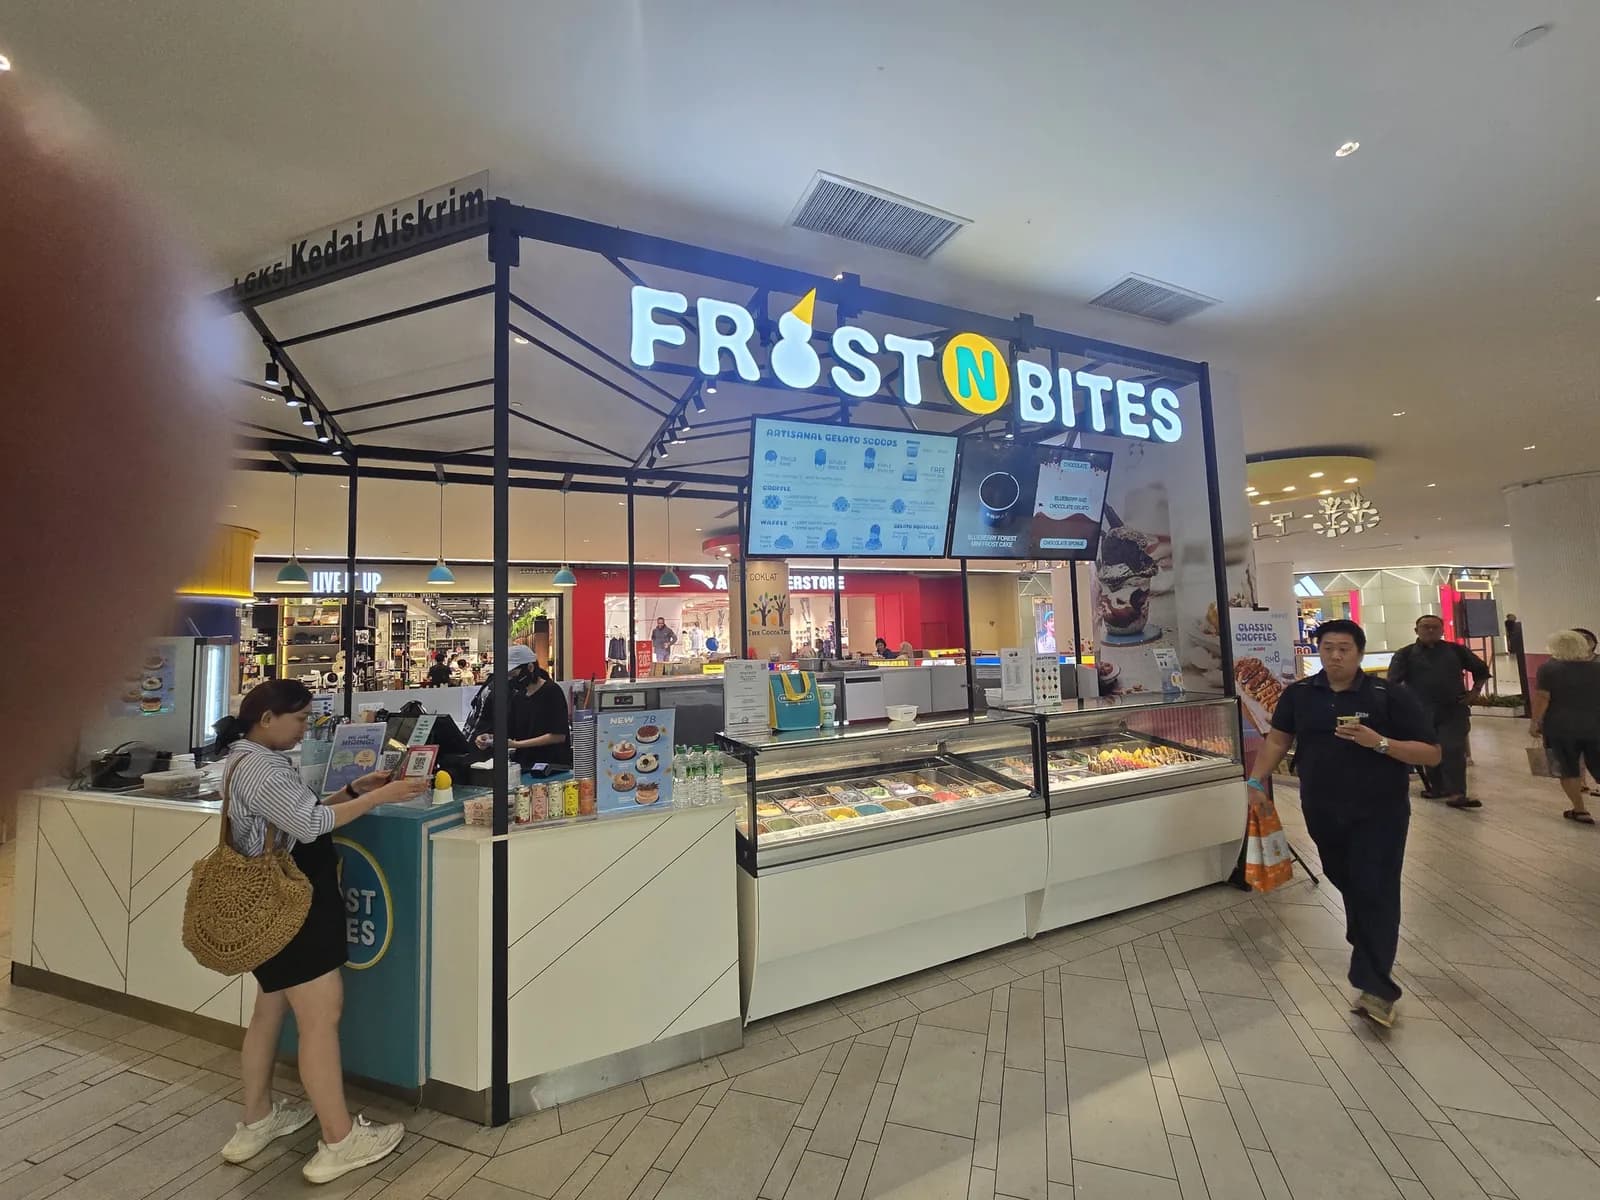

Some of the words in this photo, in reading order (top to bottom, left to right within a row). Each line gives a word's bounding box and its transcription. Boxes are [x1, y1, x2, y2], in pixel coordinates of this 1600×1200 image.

[291, 220, 363, 279] Kedai
[370, 187, 484, 252] Aiskrim
[1015, 358, 1184, 444] BITES
[766, 428, 823, 442] ARTISANAL
[825, 433, 860, 445] GELATO
[862, 437, 898, 448] SCOOPS
[312, 571, 341, 593] LIVE
[363, 571, 382, 593] UP
[1235, 632, 1277, 642] CROFFLES
[1238, 623, 1273, 633] CLASSIC
[609, 715, 634, 725] NEW
